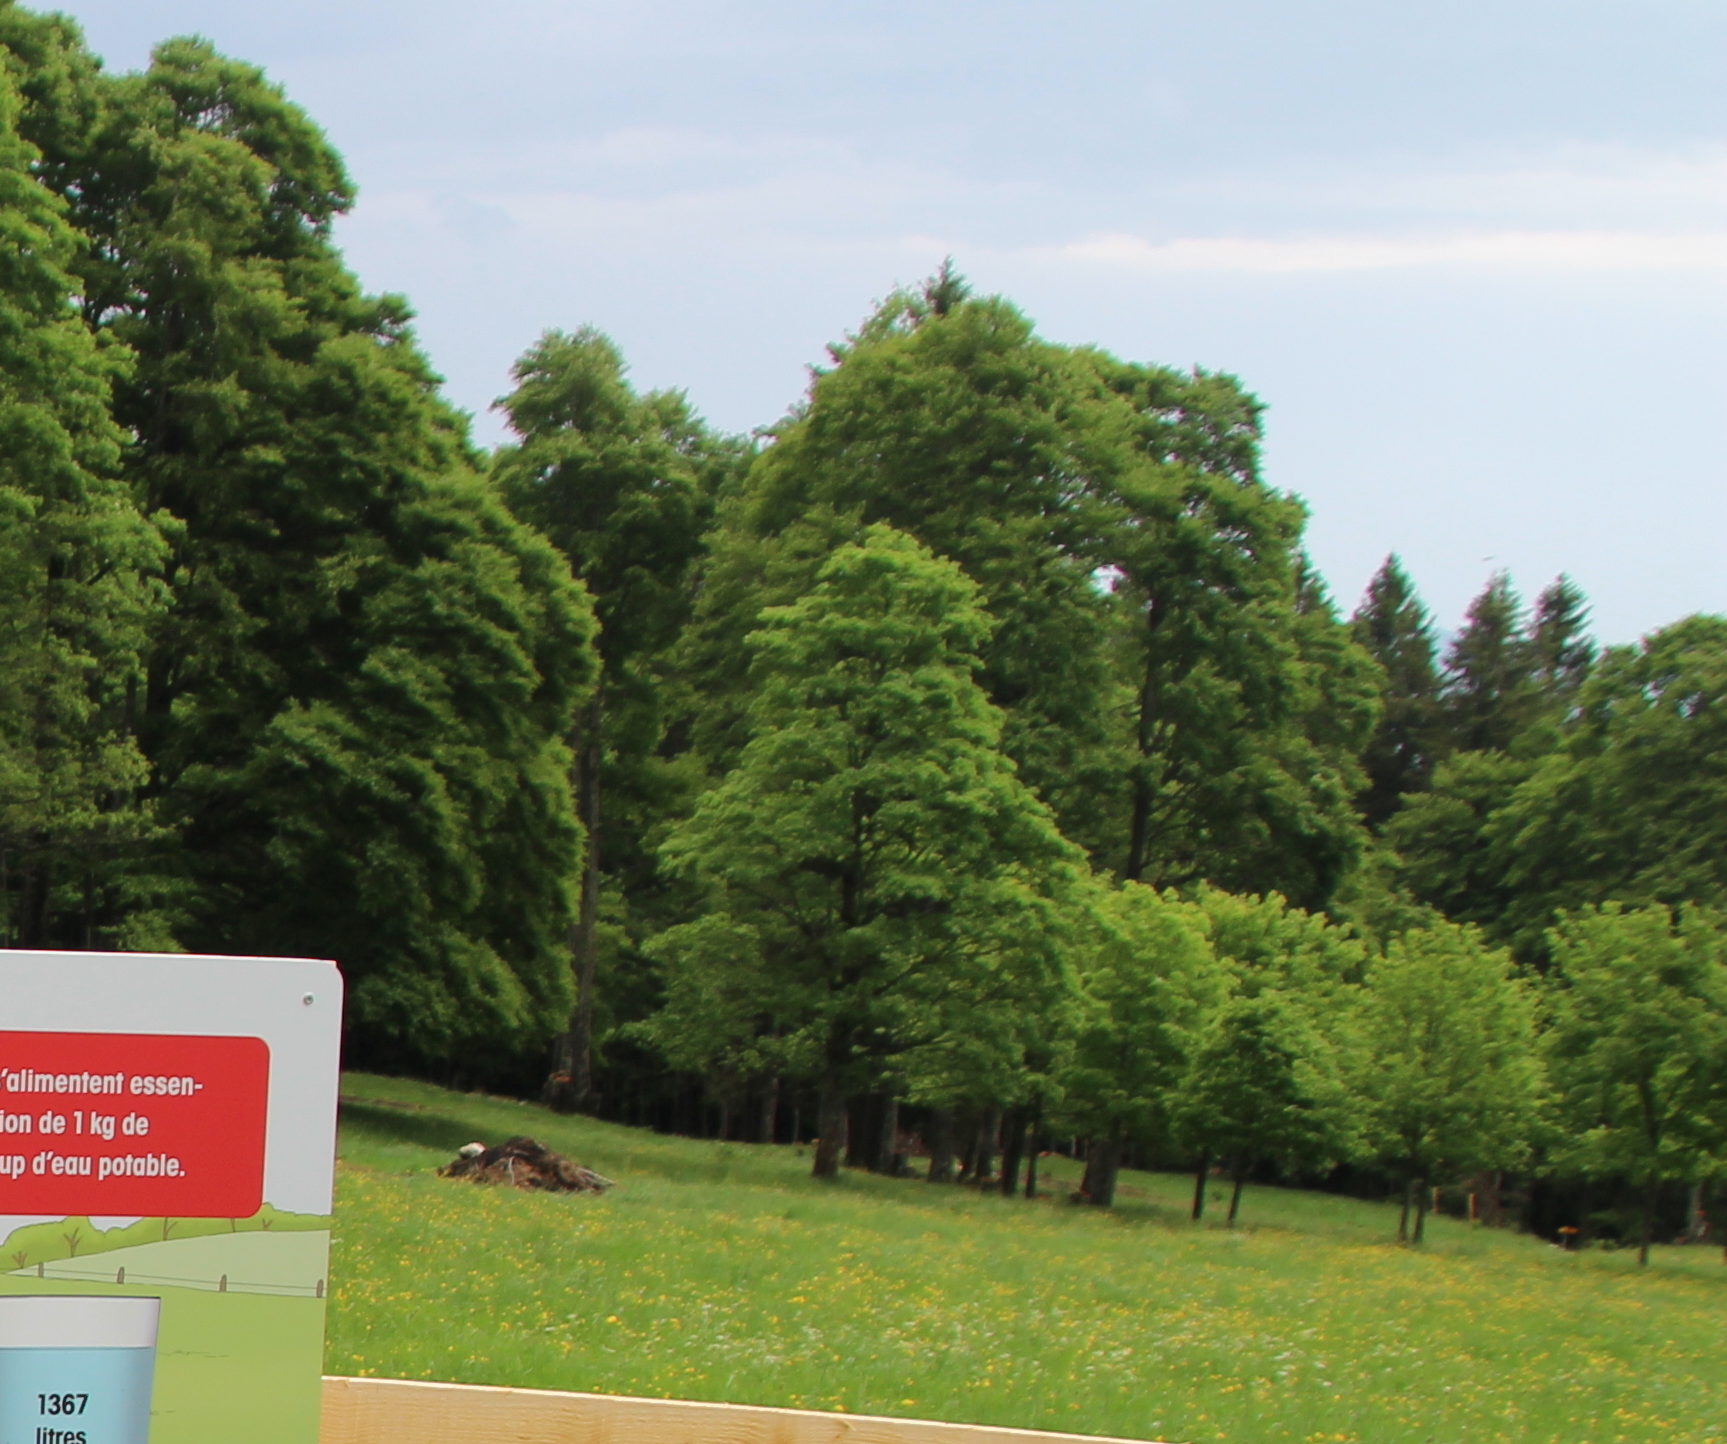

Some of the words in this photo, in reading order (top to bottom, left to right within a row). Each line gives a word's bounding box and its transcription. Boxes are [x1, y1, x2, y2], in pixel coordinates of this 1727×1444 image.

[129, 1075, 204, 1096] essen-
[38, 1110, 66, 1135] de
[73, 1110, 83, 1135] 1
[89, 1111, 116, 1141] kg
[121, 1111, 149, 1136] de
[31, 1150, 92, 1176] d'eau
[98, 1153, 186, 1181] potable.
[37, 1393, 89, 1416] 1367
